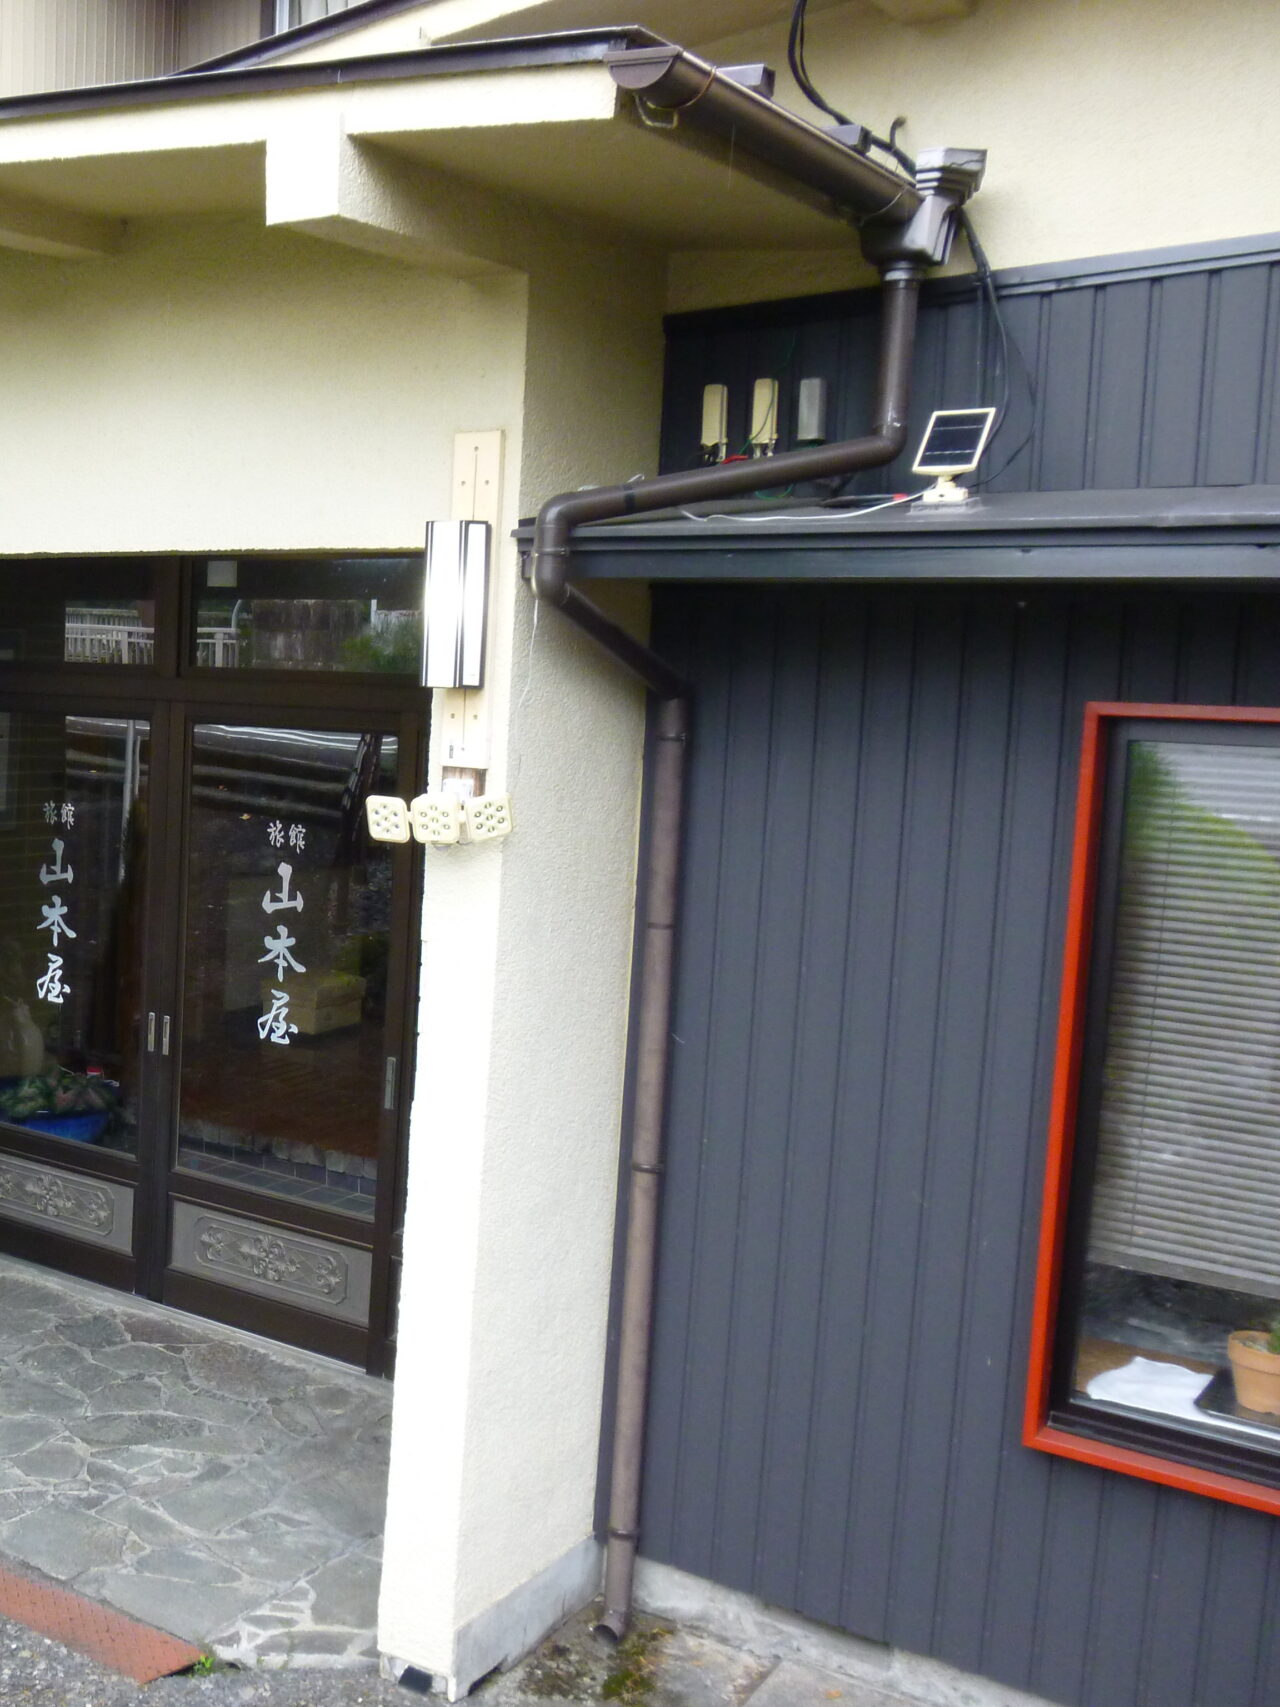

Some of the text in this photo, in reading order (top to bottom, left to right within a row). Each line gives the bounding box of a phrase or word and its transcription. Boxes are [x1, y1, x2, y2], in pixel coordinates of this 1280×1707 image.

[42, 800, 75, 830] 旅館
[266, 820, 307, 854] 旅館
[36, 838, 77, 1004] 山本屋
[257, 861, 307, 1045] 山本屋
